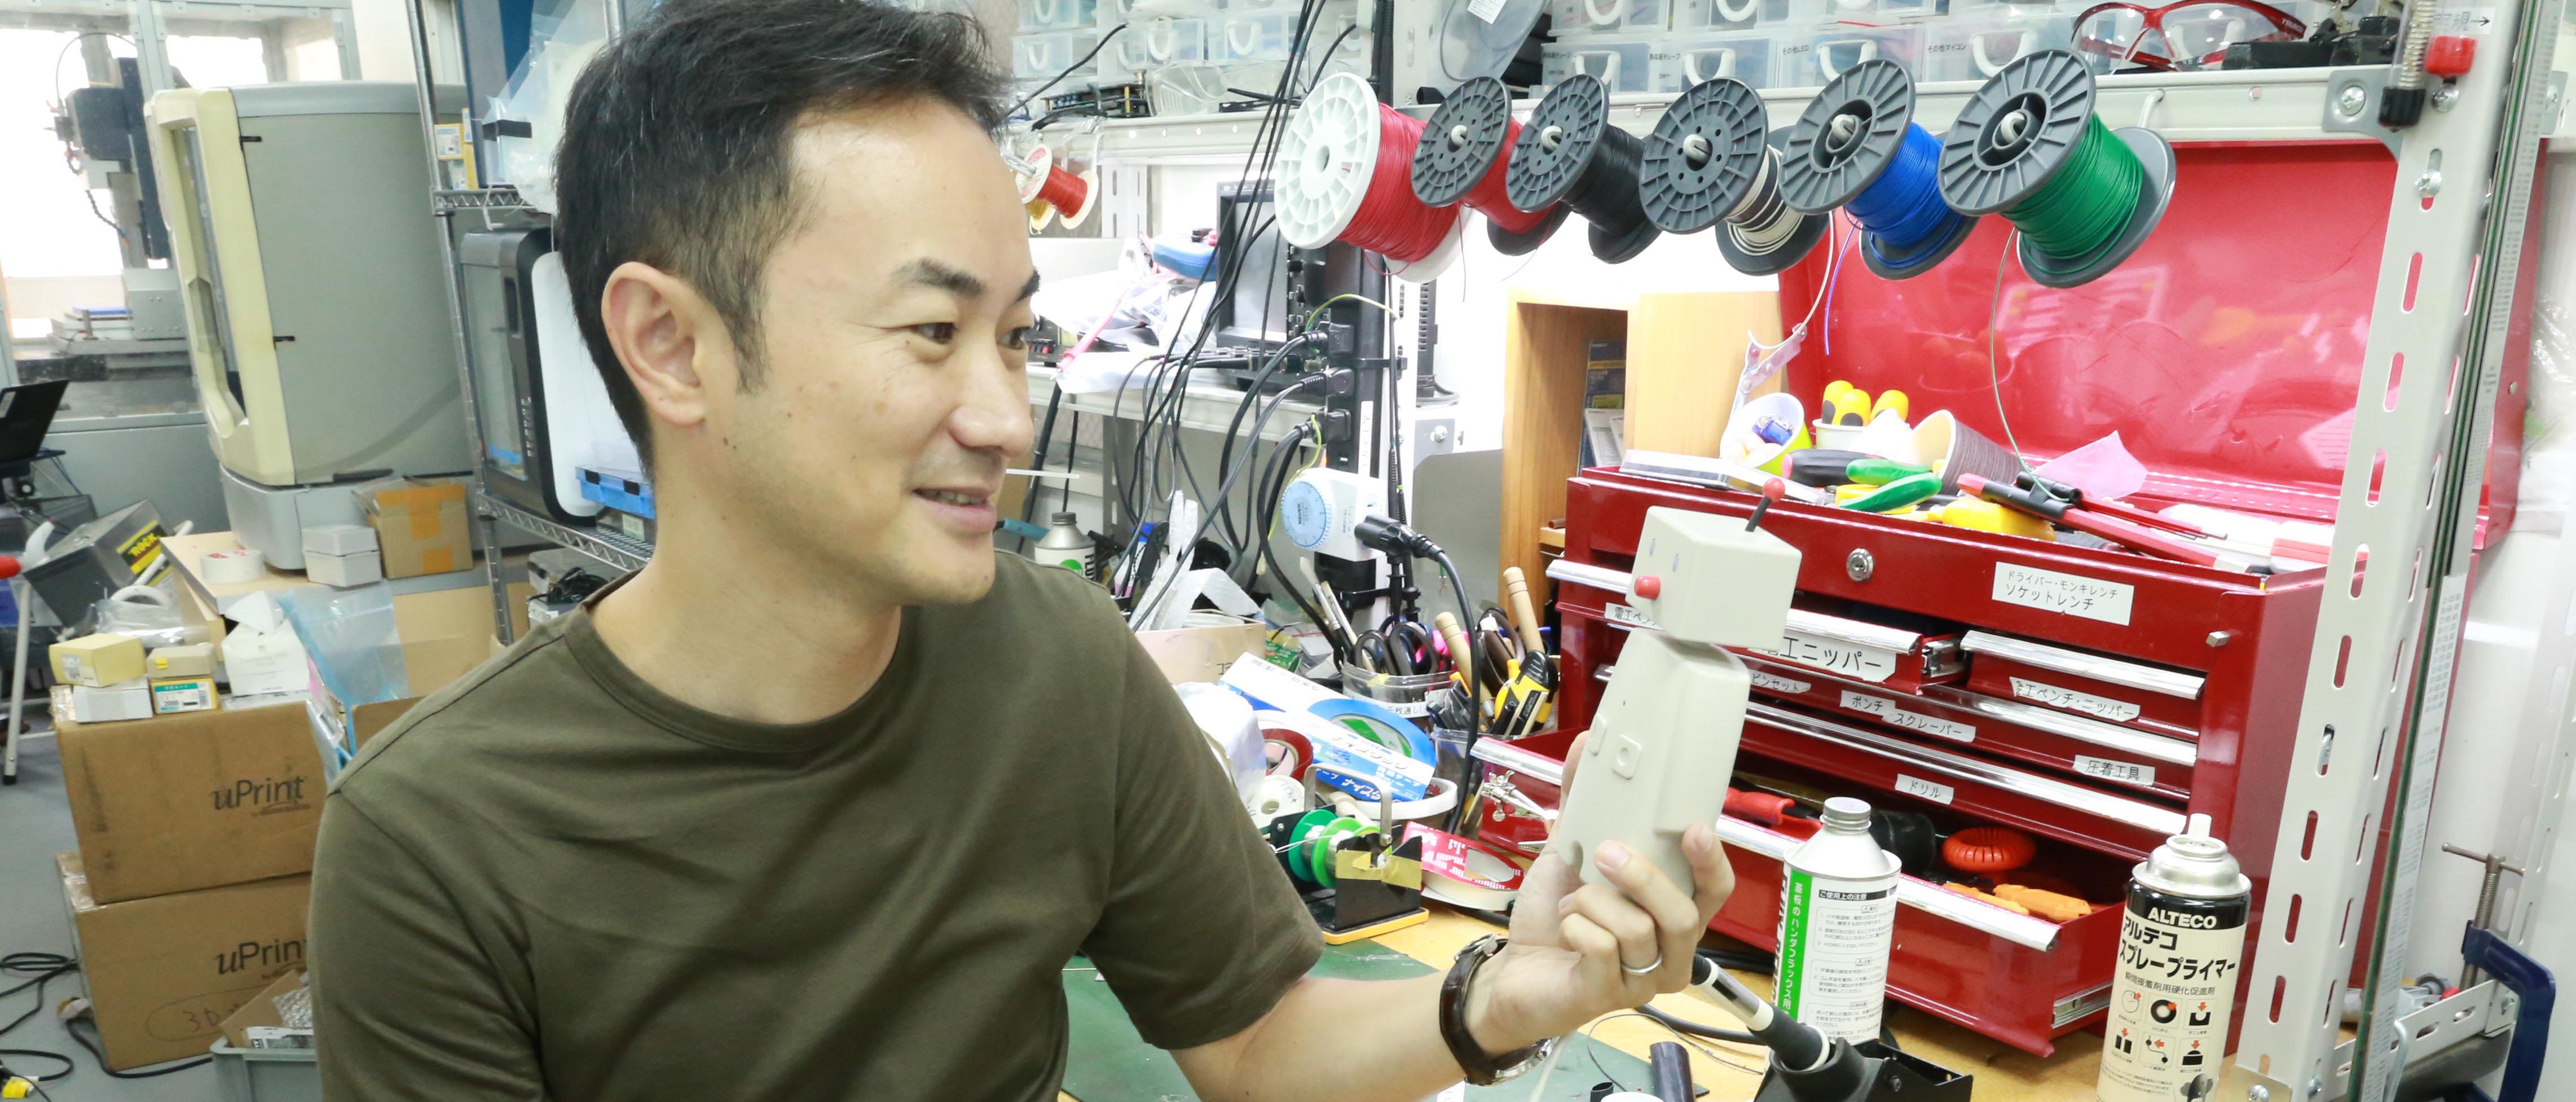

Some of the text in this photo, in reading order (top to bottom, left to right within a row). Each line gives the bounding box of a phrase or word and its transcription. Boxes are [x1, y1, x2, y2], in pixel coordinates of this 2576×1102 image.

[1782, 45, 1809, 55] その他LED
[1927, 43, 1966, 54] その他マイコン
[2008, 570, 2118, 599] ドライバー・モンキレンチ
[2006, 583, 2094, 611] ソケットレンチ
[1762, 636, 1882, 671] 工ニッパー
[1852, 695, 1883, 712] ポンチ
[1894, 713, 1962, 735] スクレーパー
[2085, 759, 2140, 781] 圧着工具
[208, 775, 306, 810] uPrint
[1909, 779, 1941, 798] ドリル
[1820, 890, 1867, 901] ご使用上の注意
[2147, 906, 2217, 929] ALTECO
[2123, 915, 2178, 951] アルテコ
[214, 938, 306, 975] uPrin
[2120, 938, 2236, 981] スプレープライマー
